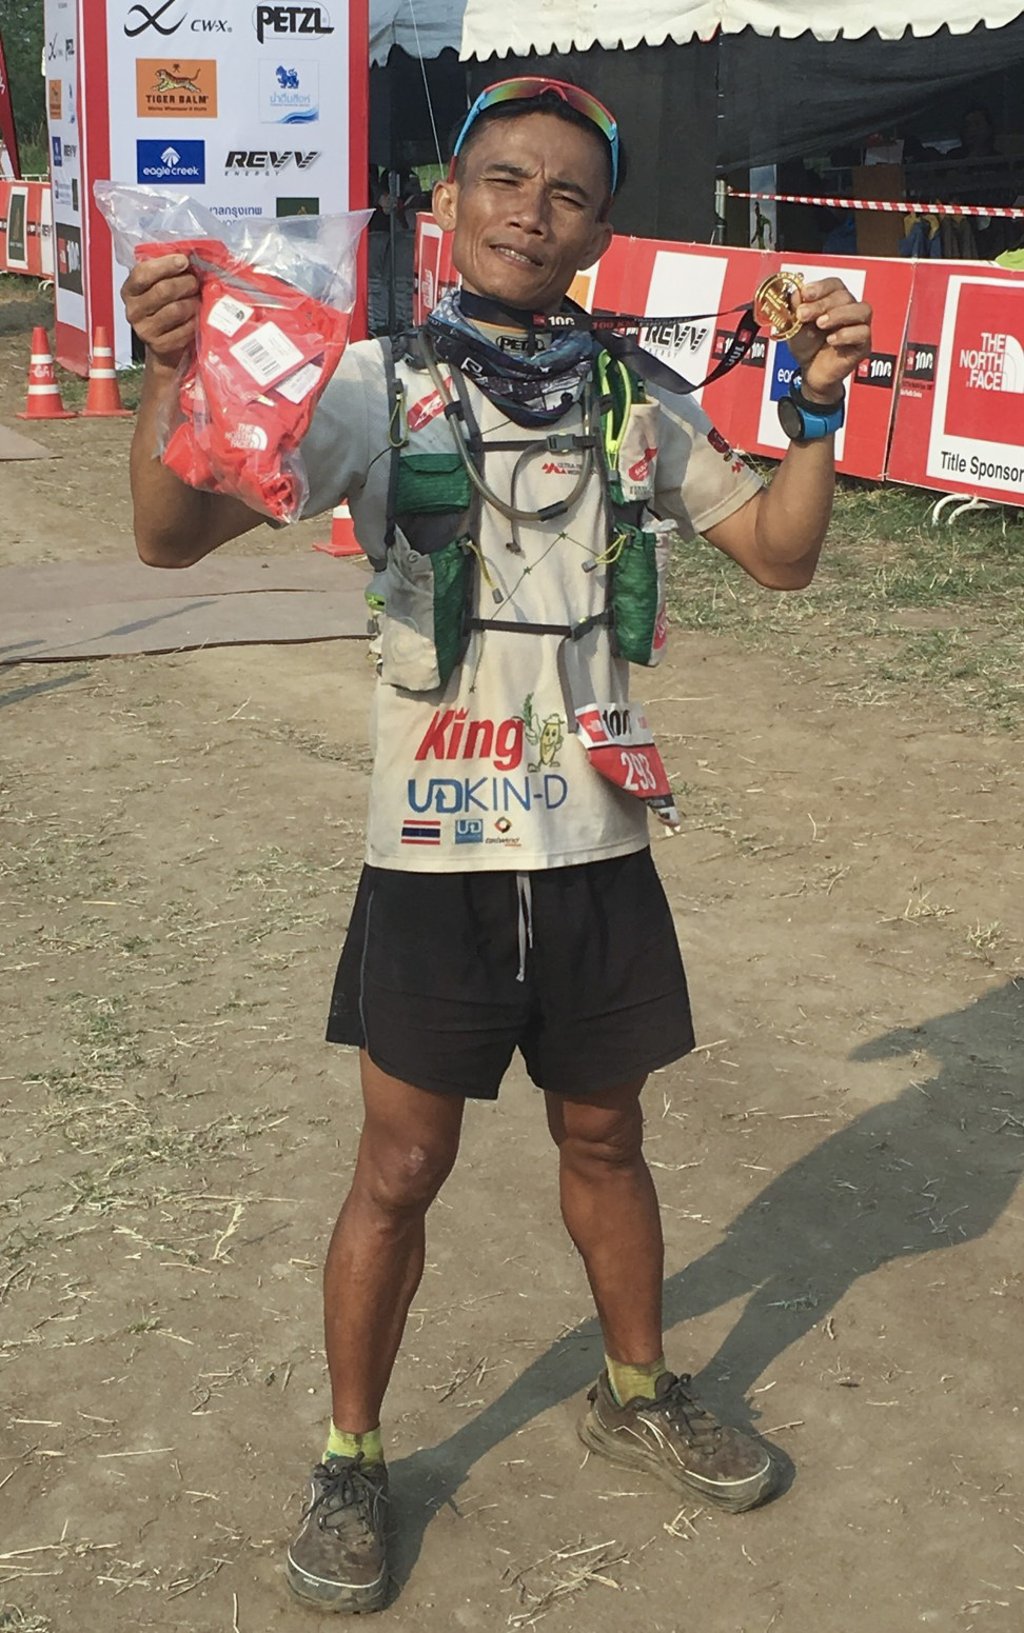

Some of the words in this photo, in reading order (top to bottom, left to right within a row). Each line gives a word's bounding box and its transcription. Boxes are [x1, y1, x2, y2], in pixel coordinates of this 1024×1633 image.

[256, 5, 334, 45] PETZL
[146, 94, 175, 104] TIGER
[178, 95, 207, 105] BALM
[225, 151, 318, 168] REVV
[644, 325, 706, 351] REVV
[980, 332, 1006, 353] THE
[870, 359, 893, 378] 100
[959, 349, 1004, 372] NORTH
[968, 369, 1002, 391] FACE
[941, 450, 967, 473] Title
[969, 455, 1024, 484] Sponsor
[415, 707, 524, 772] King
[620, 751, 657, 791] 293
